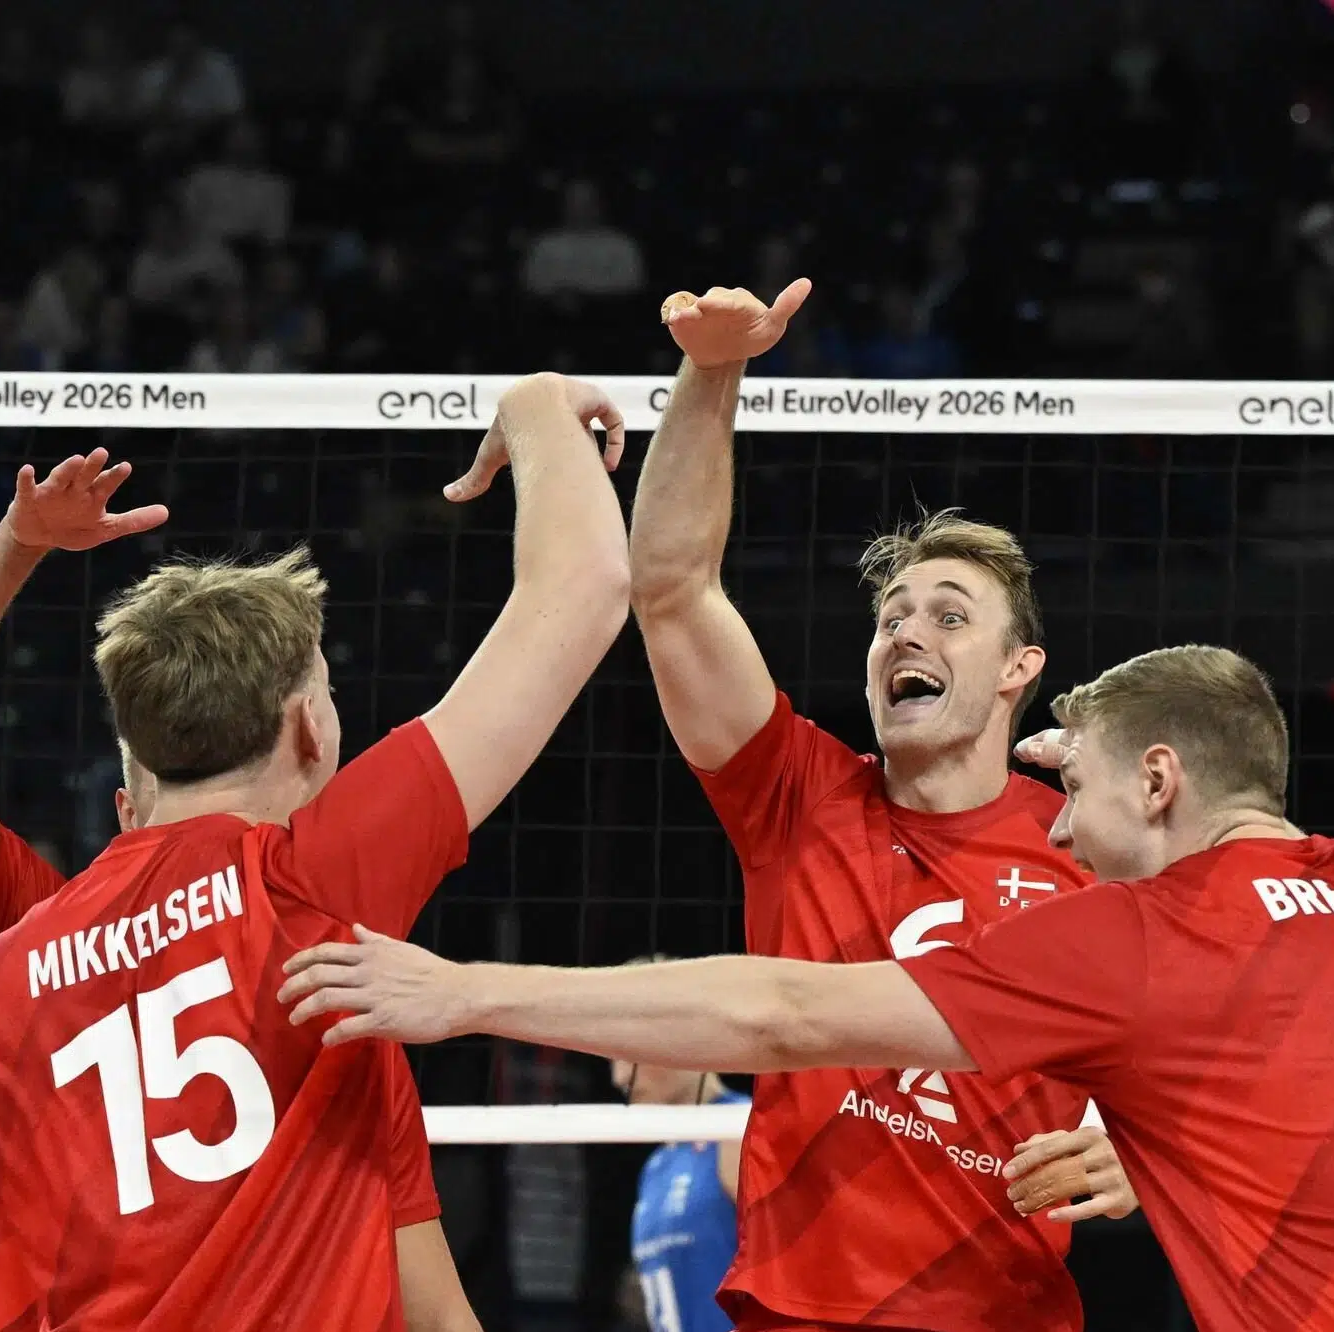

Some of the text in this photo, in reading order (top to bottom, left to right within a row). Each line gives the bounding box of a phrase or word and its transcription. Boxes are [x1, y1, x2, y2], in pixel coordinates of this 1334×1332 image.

[63, 383, 131, 409] 2026
[142, 383, 205, 409] Men
[377, 383, 480, 421] enel
[739, 387, 1074, 421] nel EuroVolley 2026 Men
[1238, 390, 1334, 425] enel
[28, 864, 244, 999] MIKKELSEN
[50, 956, 276, 1216] 15
